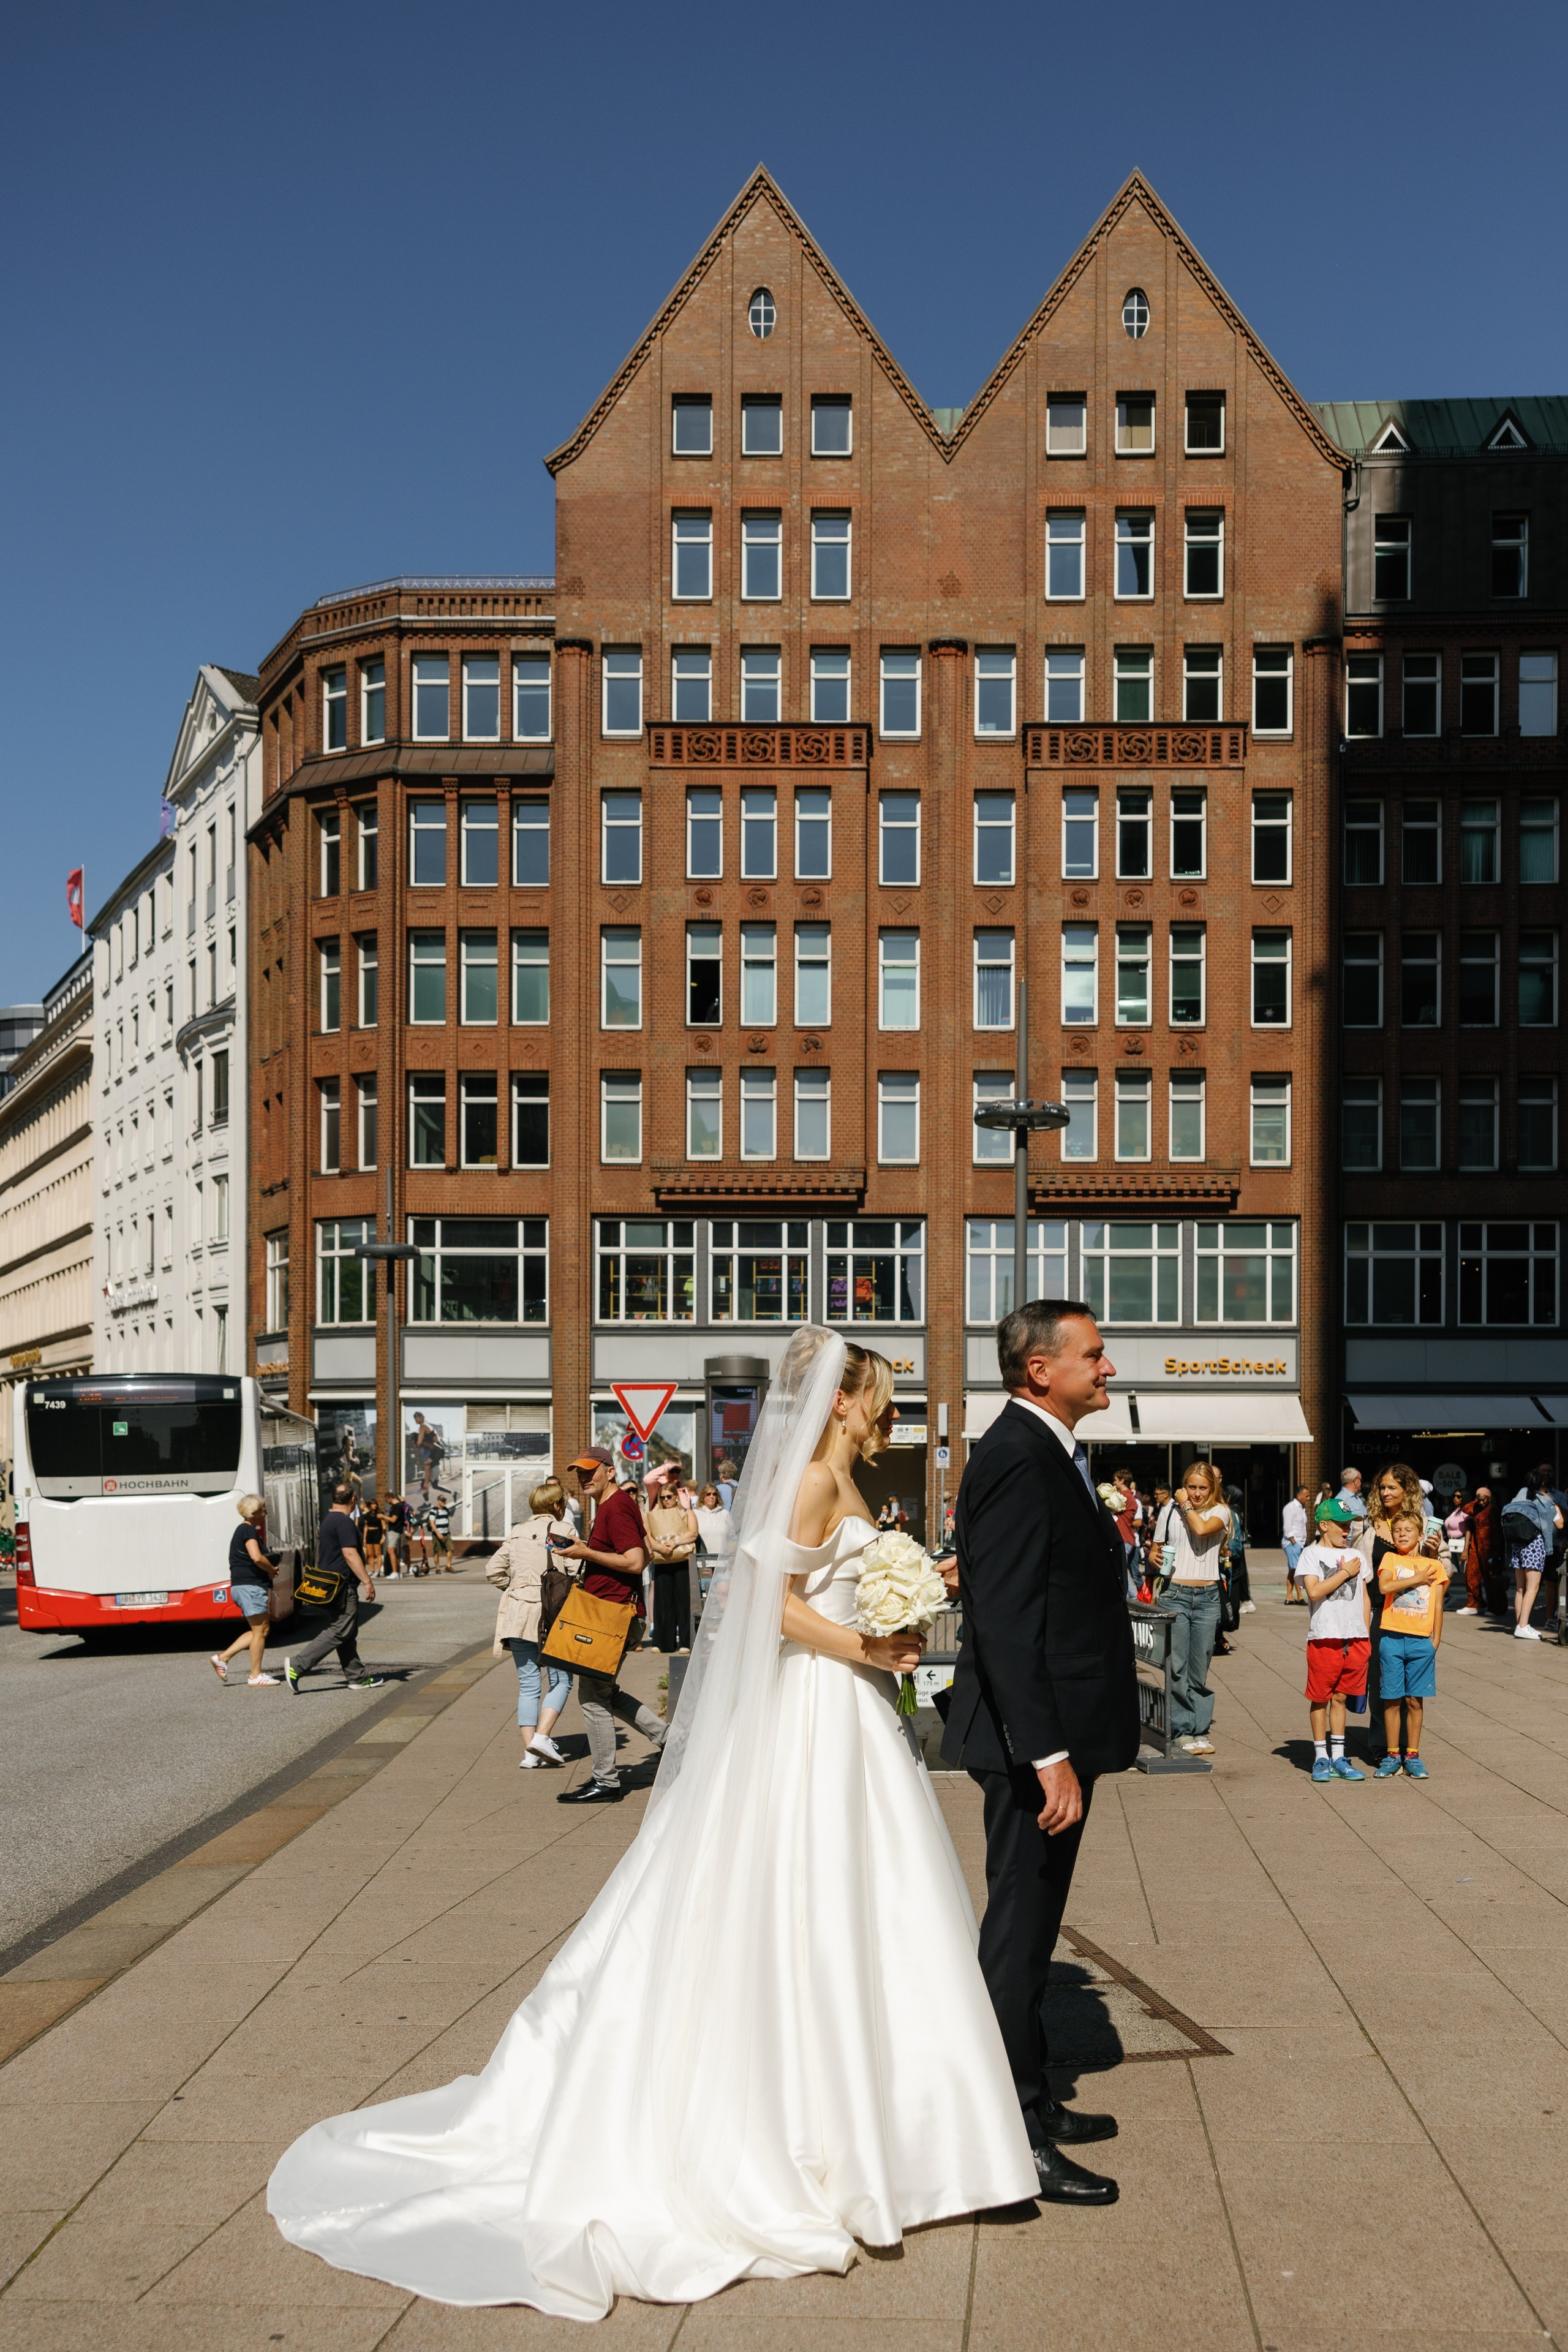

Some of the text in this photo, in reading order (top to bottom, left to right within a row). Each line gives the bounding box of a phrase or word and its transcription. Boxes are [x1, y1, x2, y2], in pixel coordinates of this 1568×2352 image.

[1165, 1357, 1286, 1376] SportScheck
[44, 1400, 66, 1409] 7439
[1351, 1443, 1400, 1455] TECHLAB
[1438, 1471, 1461, 1479] SALE
[119, 1479, 189, 1489] HOCHBAHN
[149, 1593, 168, 1602] 1439
